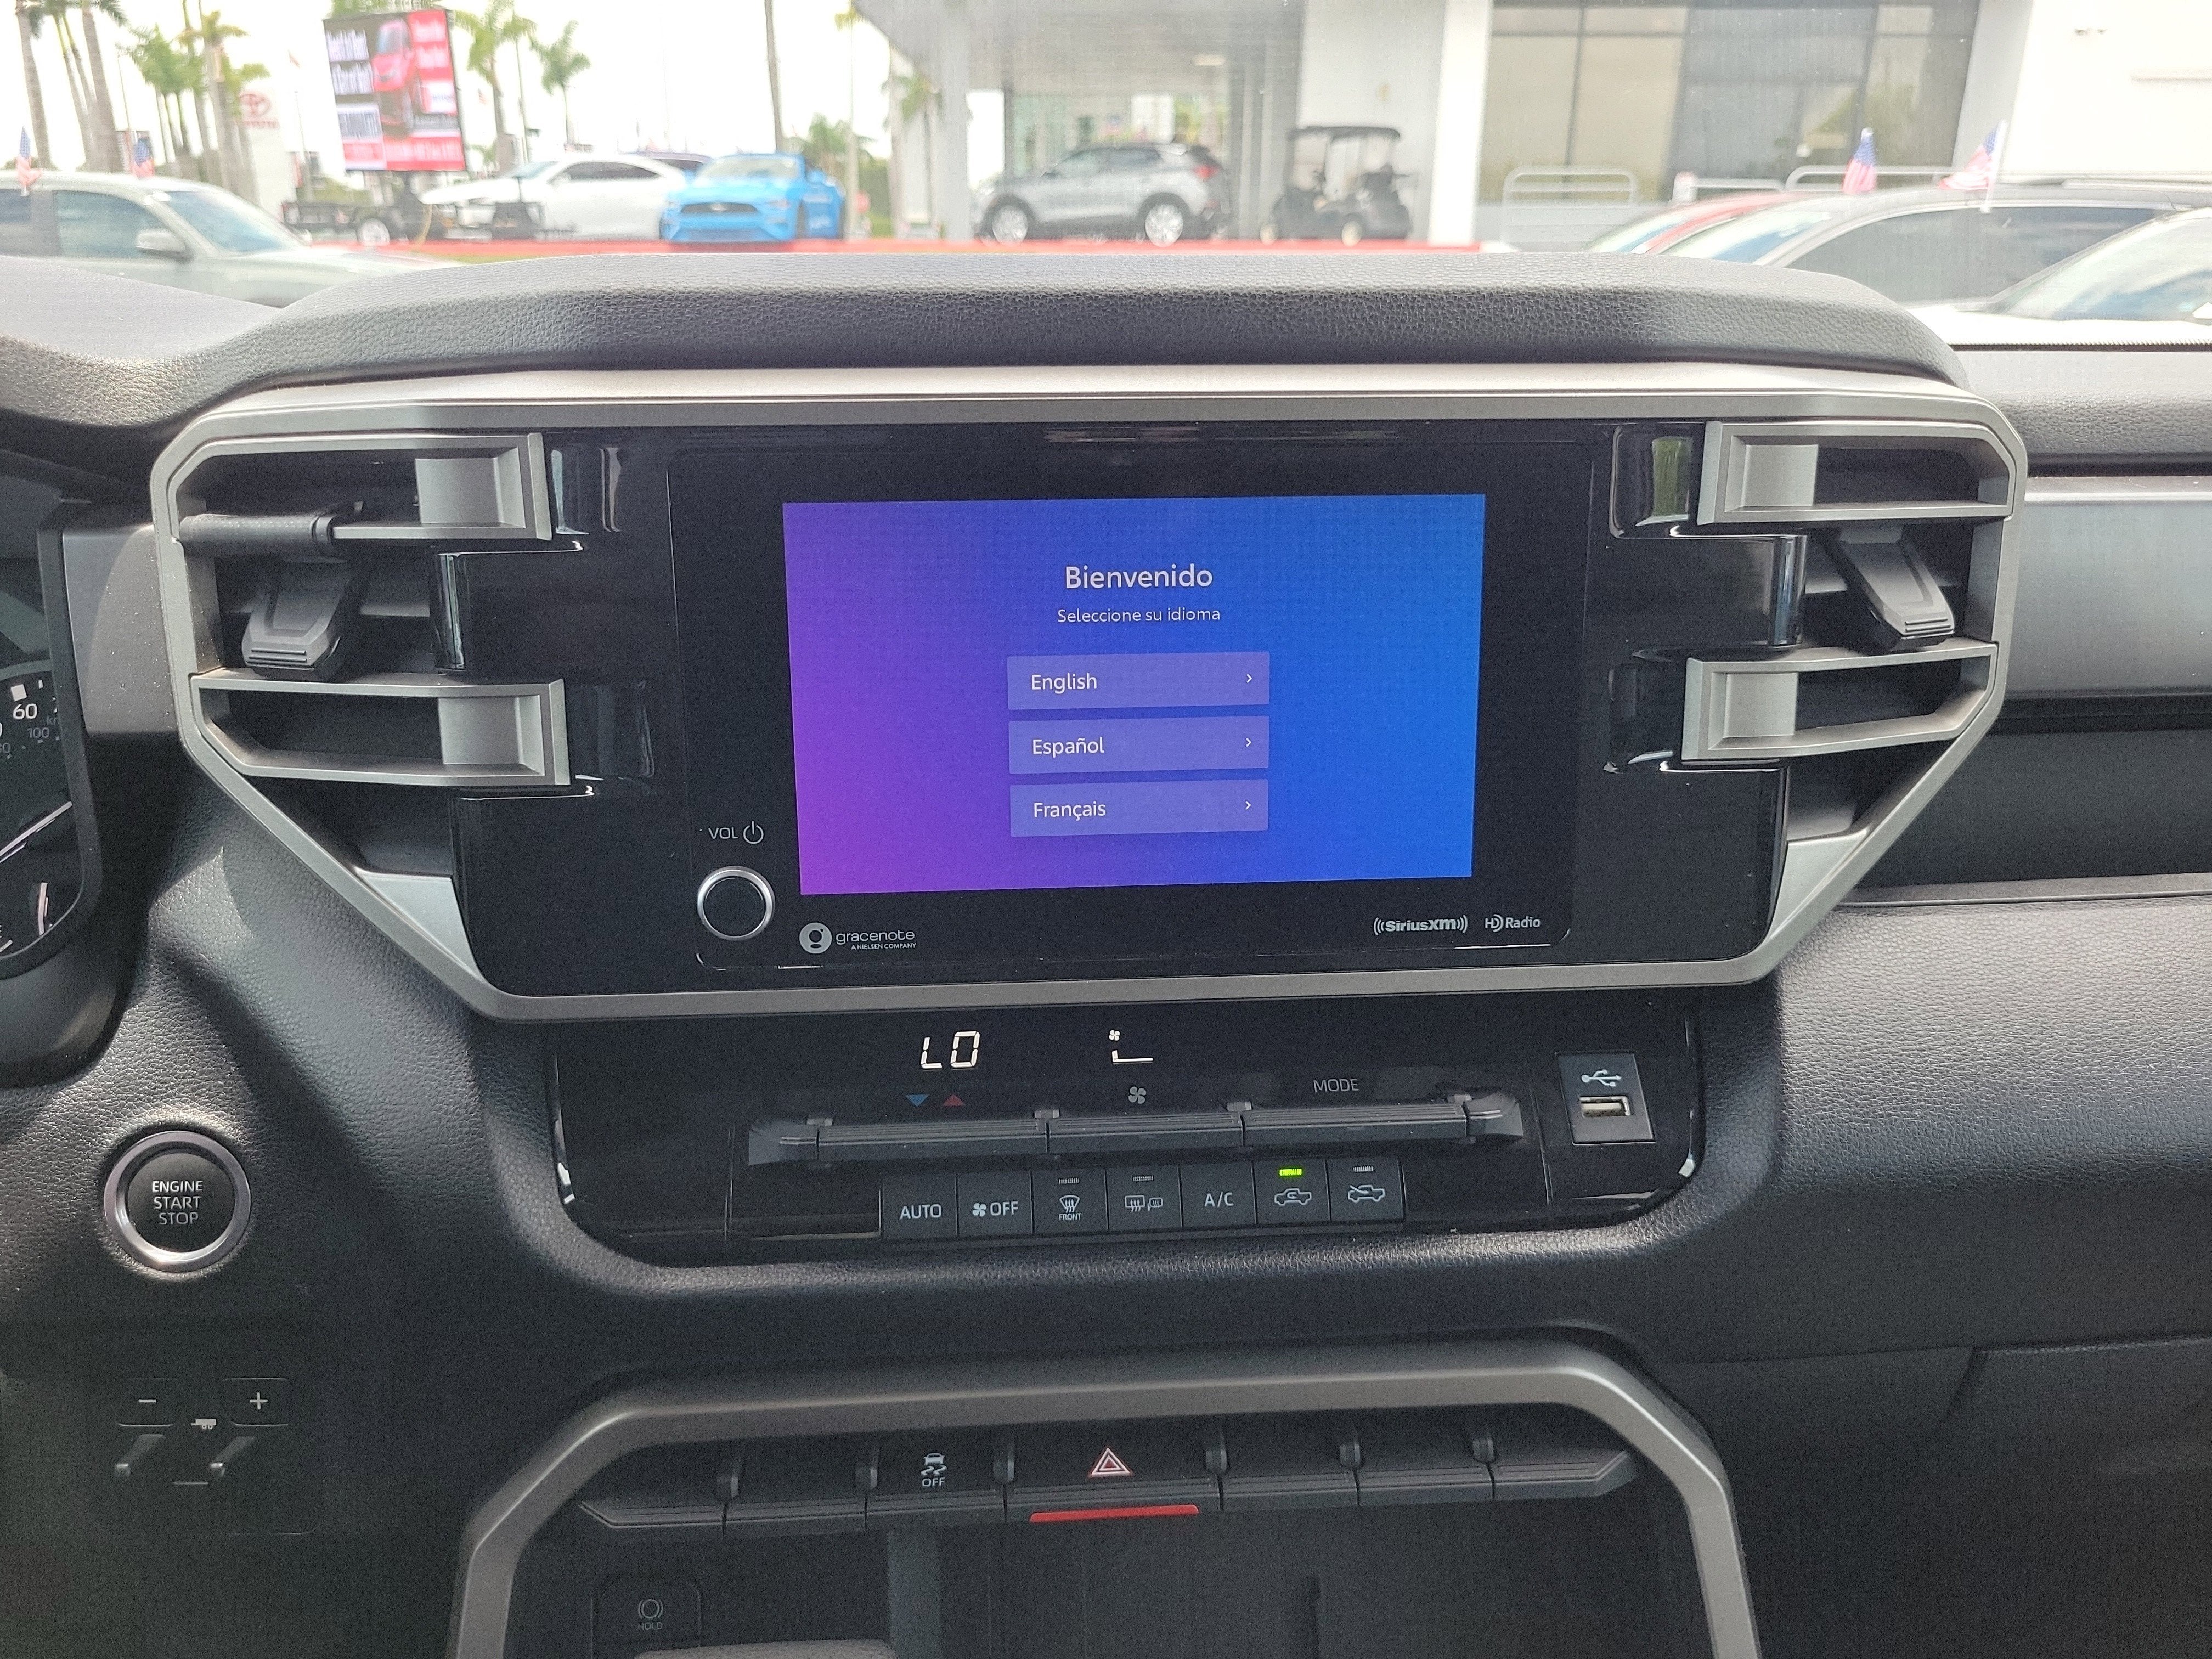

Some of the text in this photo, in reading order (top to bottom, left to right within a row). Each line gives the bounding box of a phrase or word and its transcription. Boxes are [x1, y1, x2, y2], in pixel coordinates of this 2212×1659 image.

[1065, 564, 1213, 589] Bienvenido
[1058, 606, 1221, 623] Seleccione su idioma
[1031, 673, 1097, 694] English
[13, 703, 38, 719] 60
[27, 727, 50, 738] 100
[1032, 737, 1105, 757] Español
[1033, 801, 1107, 821] Français
[708, 827, 738, 840] VOL
[1505, 916, 1542, 929] Radio
[836, 929, 915, 945] gracenote
[920, 1031, 980, 1069] LO
[1313, 1078, 1359, 1092] MODE
[153, 1180, 204, 1192] ENGINE
[154, 1196, 201, 1210] START
[1204, 1191, 1234, 1208] A/C
[899, 1204, 942, 1220] AUTO
[990, 1201, 1019, 1216] OFF
[159, 1212, 199, 1224] STOP
[1059, 1212, 1081, 1221] FRONT
[922, 1477, 945, 1487] OFF
[637, 1622, 663, 1630] HOLD
